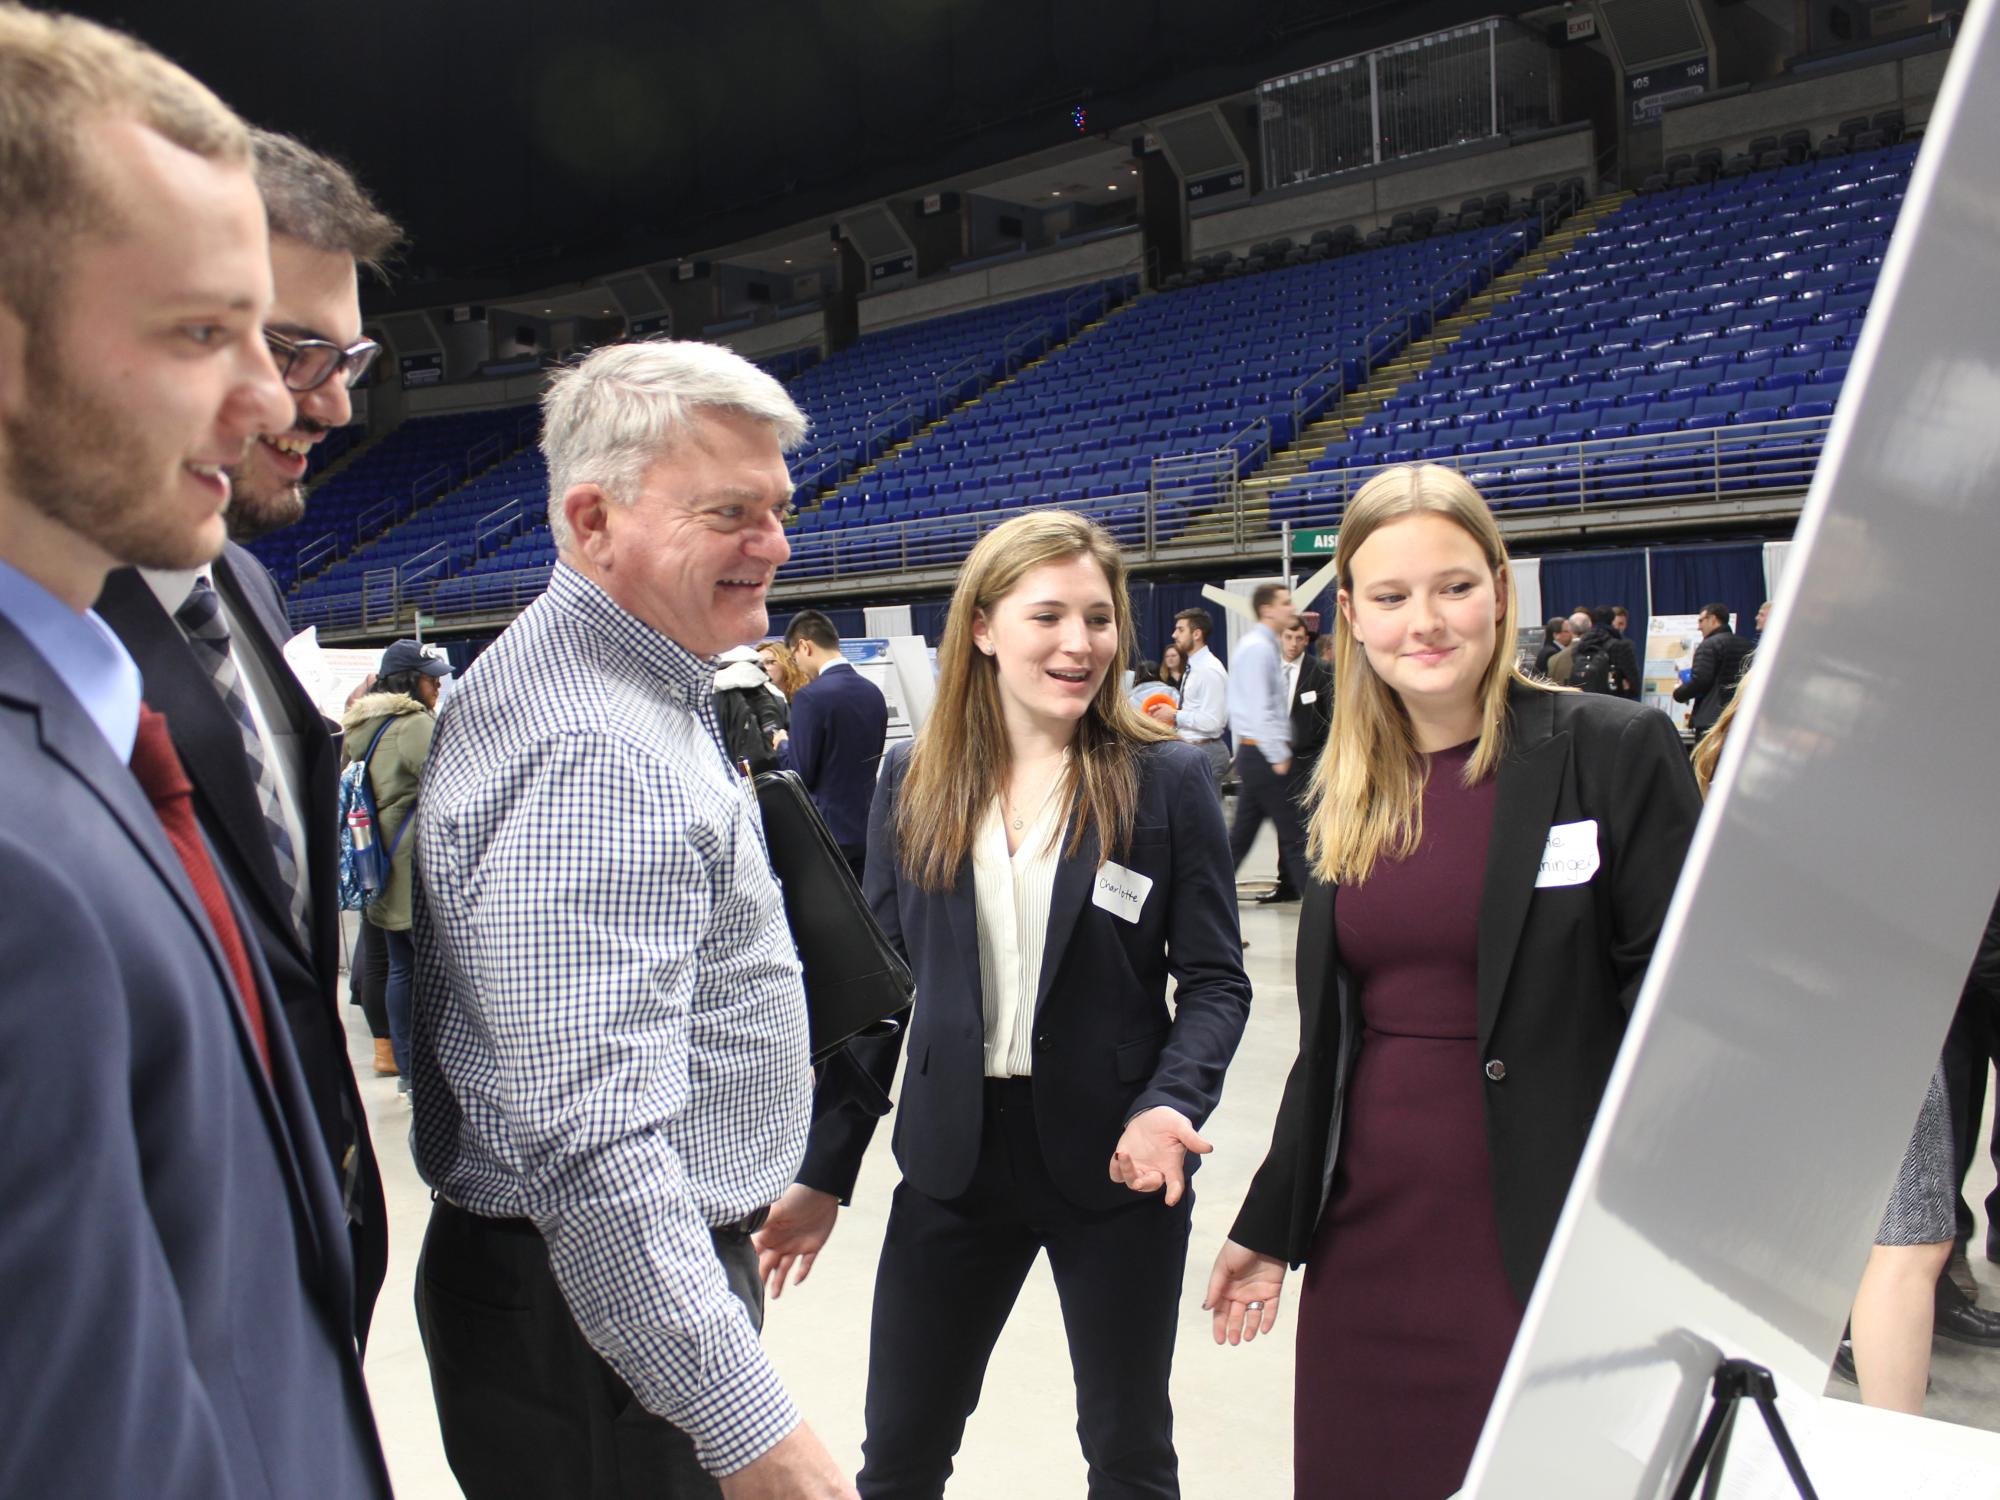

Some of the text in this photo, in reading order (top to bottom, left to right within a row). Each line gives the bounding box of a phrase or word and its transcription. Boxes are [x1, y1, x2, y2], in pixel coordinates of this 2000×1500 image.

[1568, 19, 1592, 34] EXIT
[1632, 64, 1705, 89] 105 106
[1540, 854, 1594, 881] ninger
[1100, 878, 1138, 902] Charlotte
